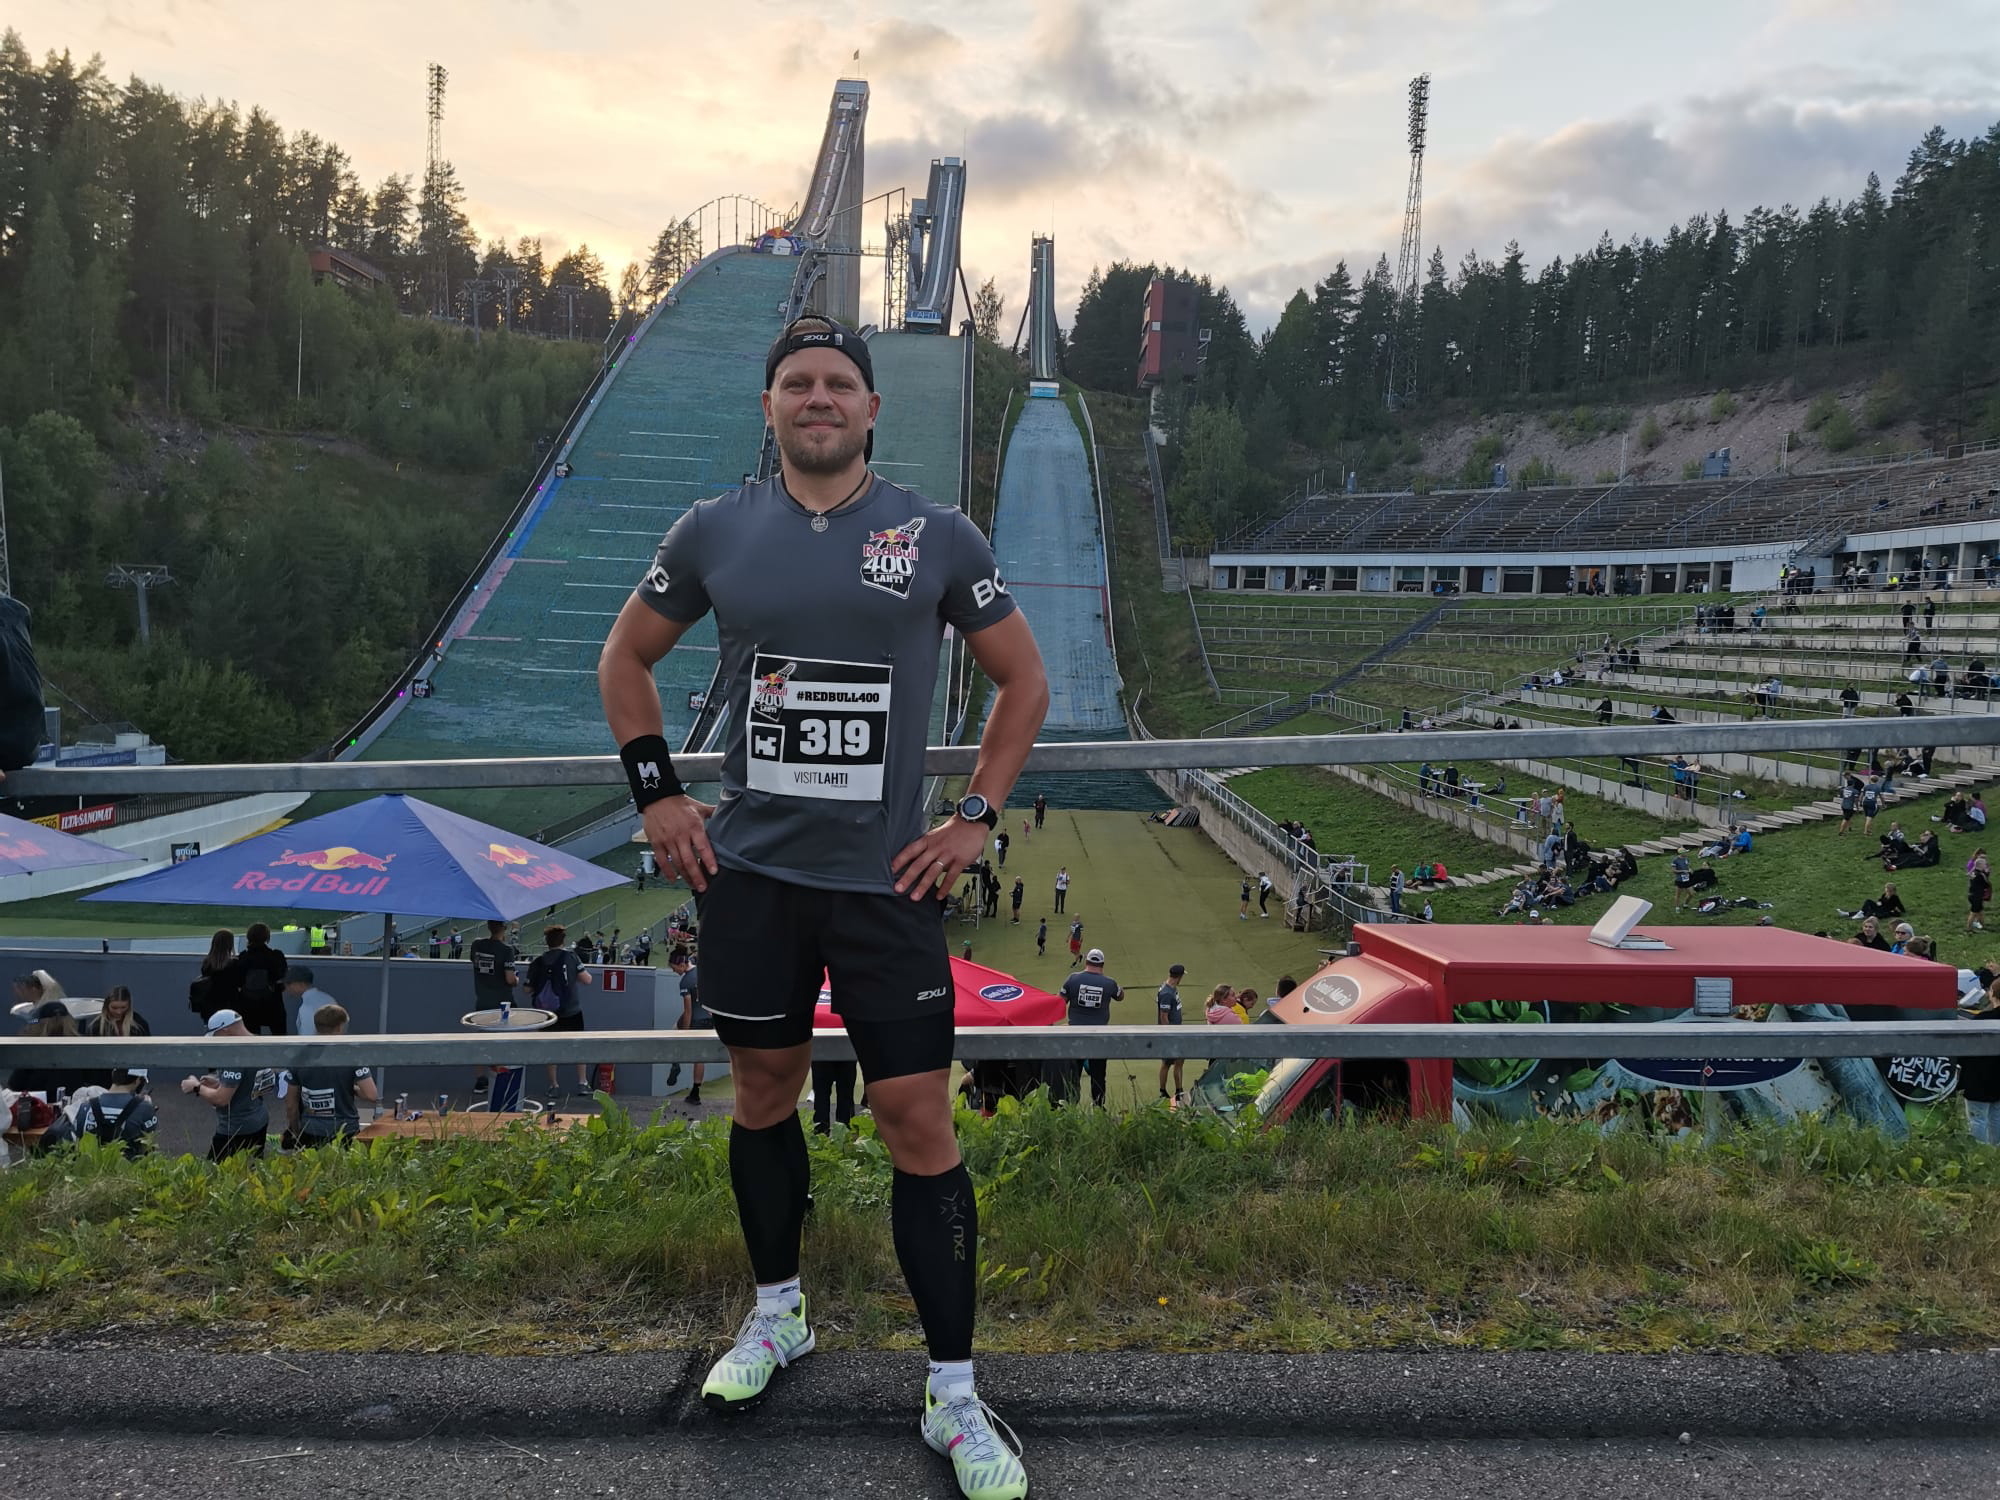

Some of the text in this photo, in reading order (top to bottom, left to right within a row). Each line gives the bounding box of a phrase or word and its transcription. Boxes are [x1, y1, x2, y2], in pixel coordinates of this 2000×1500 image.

[863, 543, 919, 561] Red Bull
[873, 574, 904, 584] LAHTI
[796, 691, 880, 703] #REDBULL400
[799, 718, 871, 757] 319
[232, 871, 392, 896] Red Bull
[916, 986, 947, 1000] 2XU
[1888, 1064, 1946, 1092] MEALS
